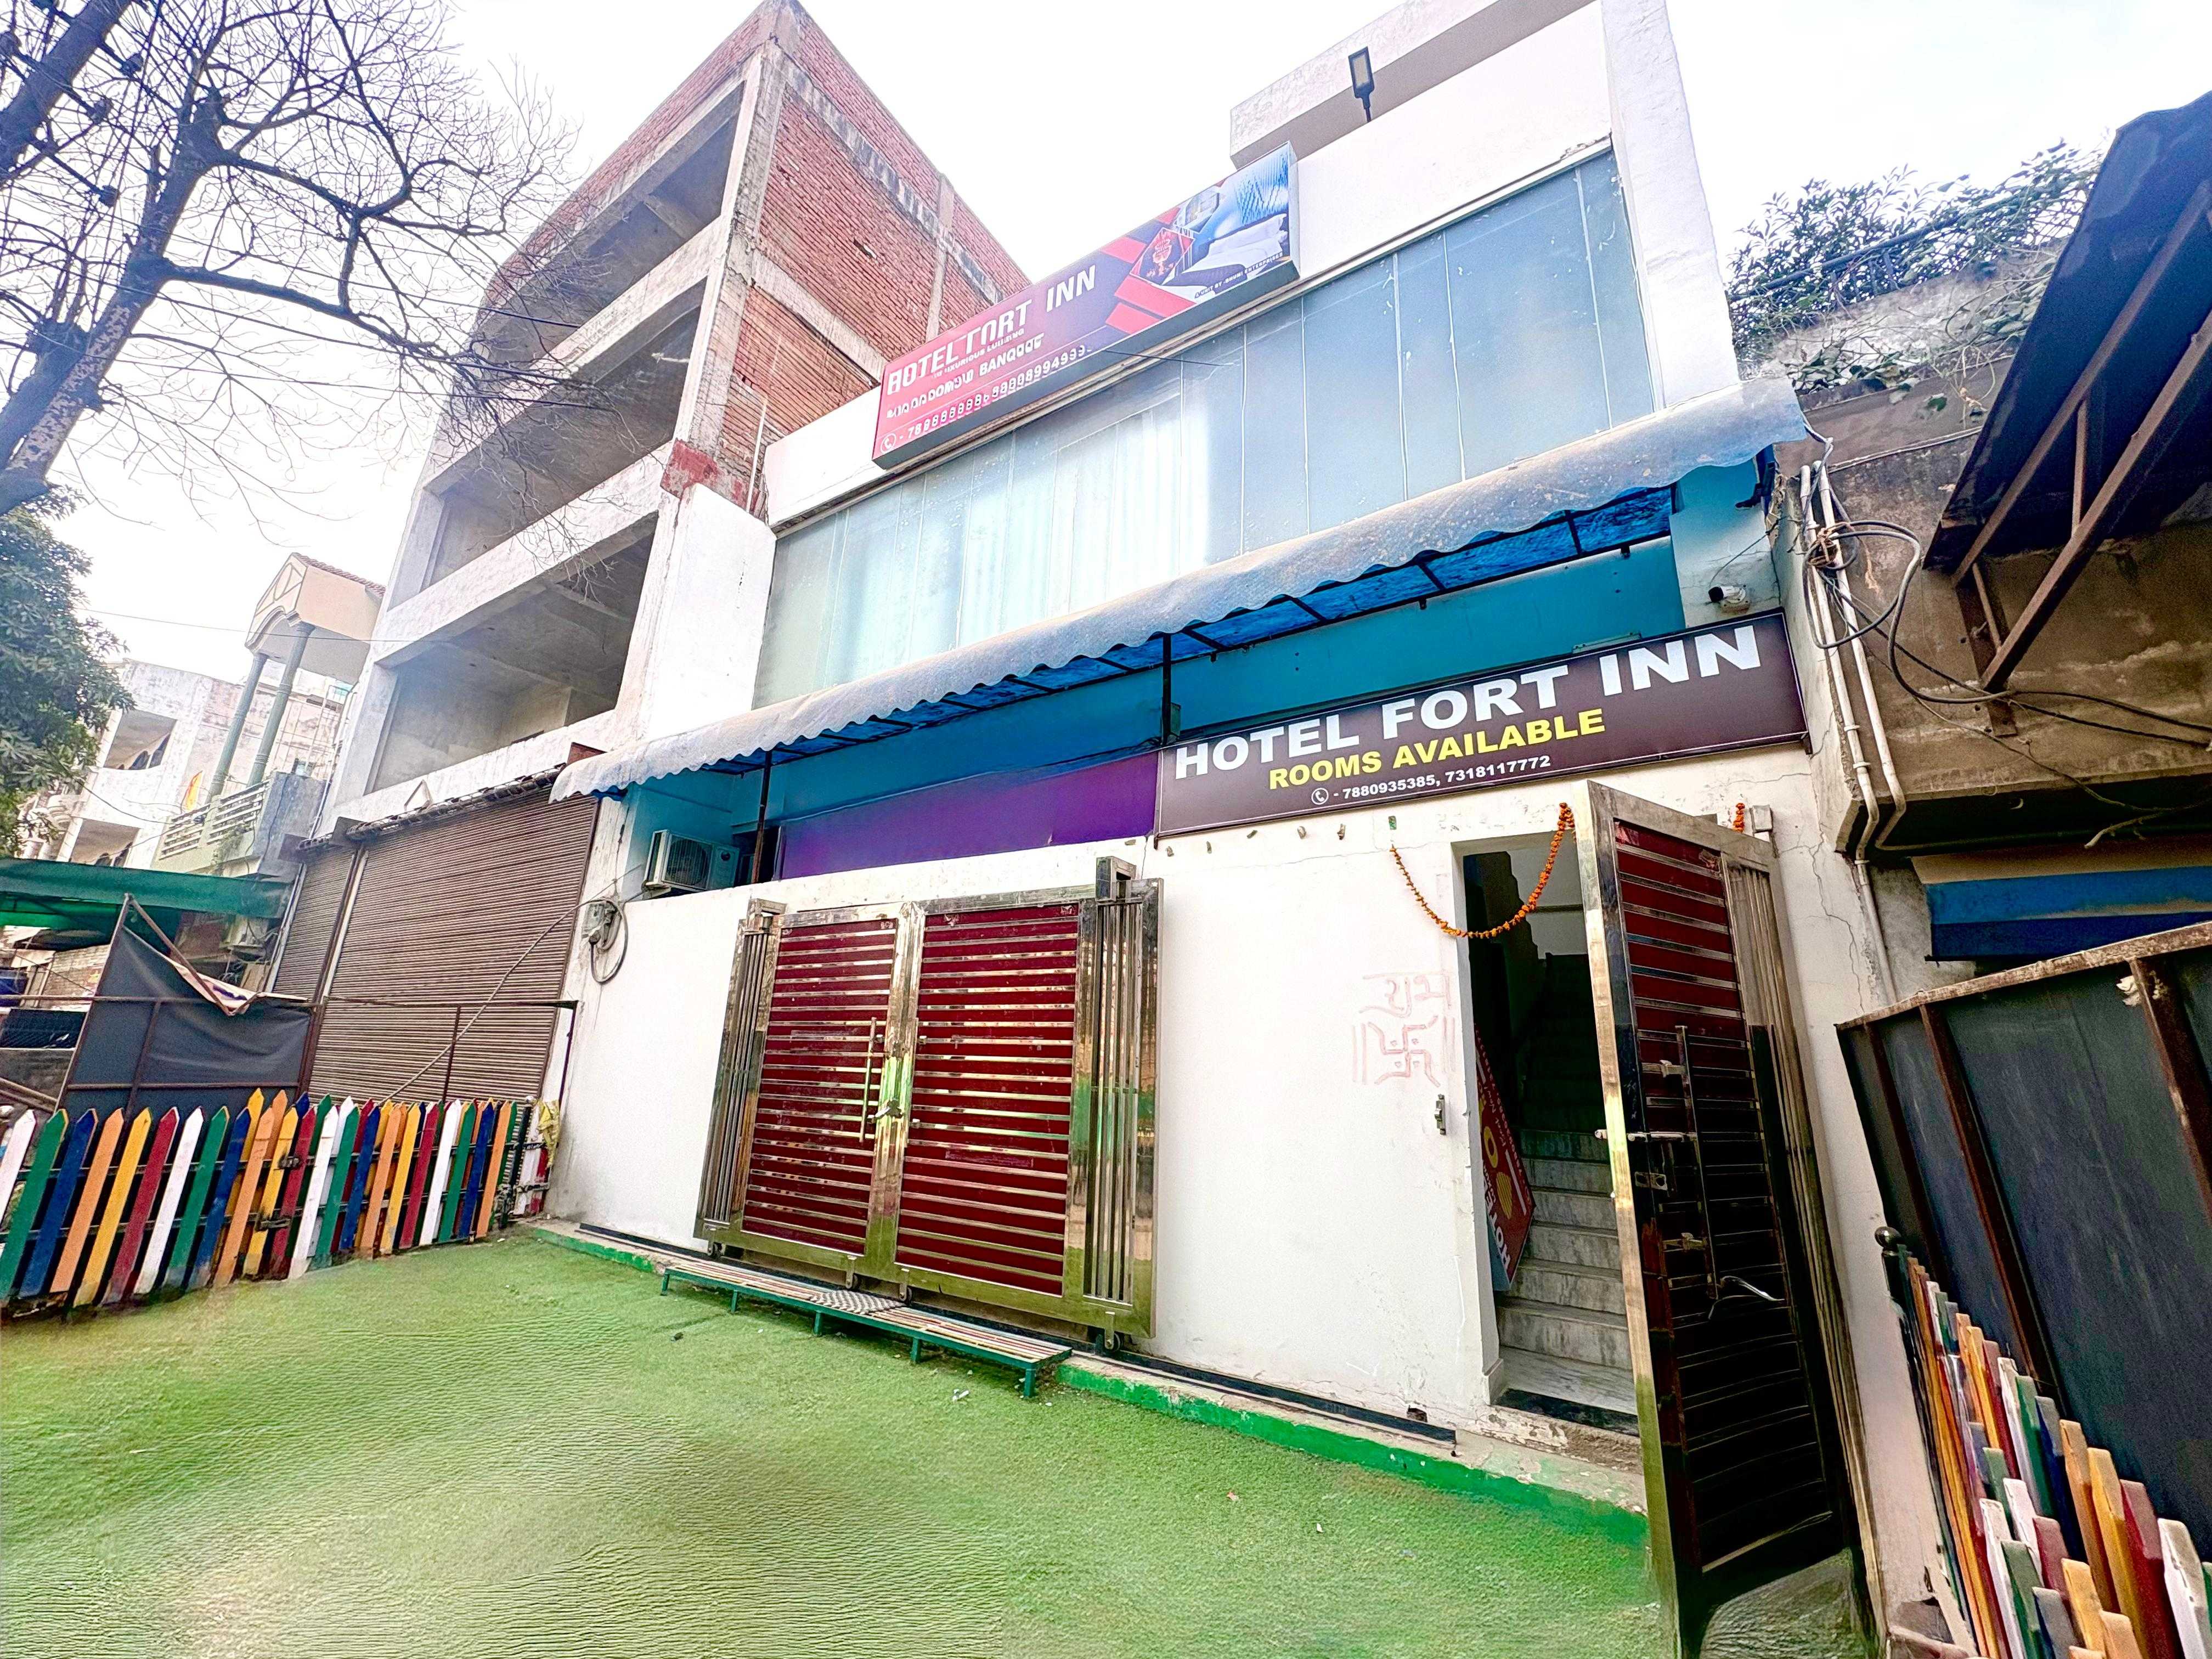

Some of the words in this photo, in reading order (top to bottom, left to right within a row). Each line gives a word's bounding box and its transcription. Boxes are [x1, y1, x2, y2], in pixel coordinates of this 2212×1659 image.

[1046, 265, 1096, 312] INN
[1176, 714, 1359, 780] HOTEL
[1381, 664, 1569, 740] FORT
[1599, 625, 1760, 696] INN
[1269, 751, 1381, 789] ROOMS
[1393, 708, 1606, 769] AVAILABLE
[1445, 755, 1551, 783] 7318117772
